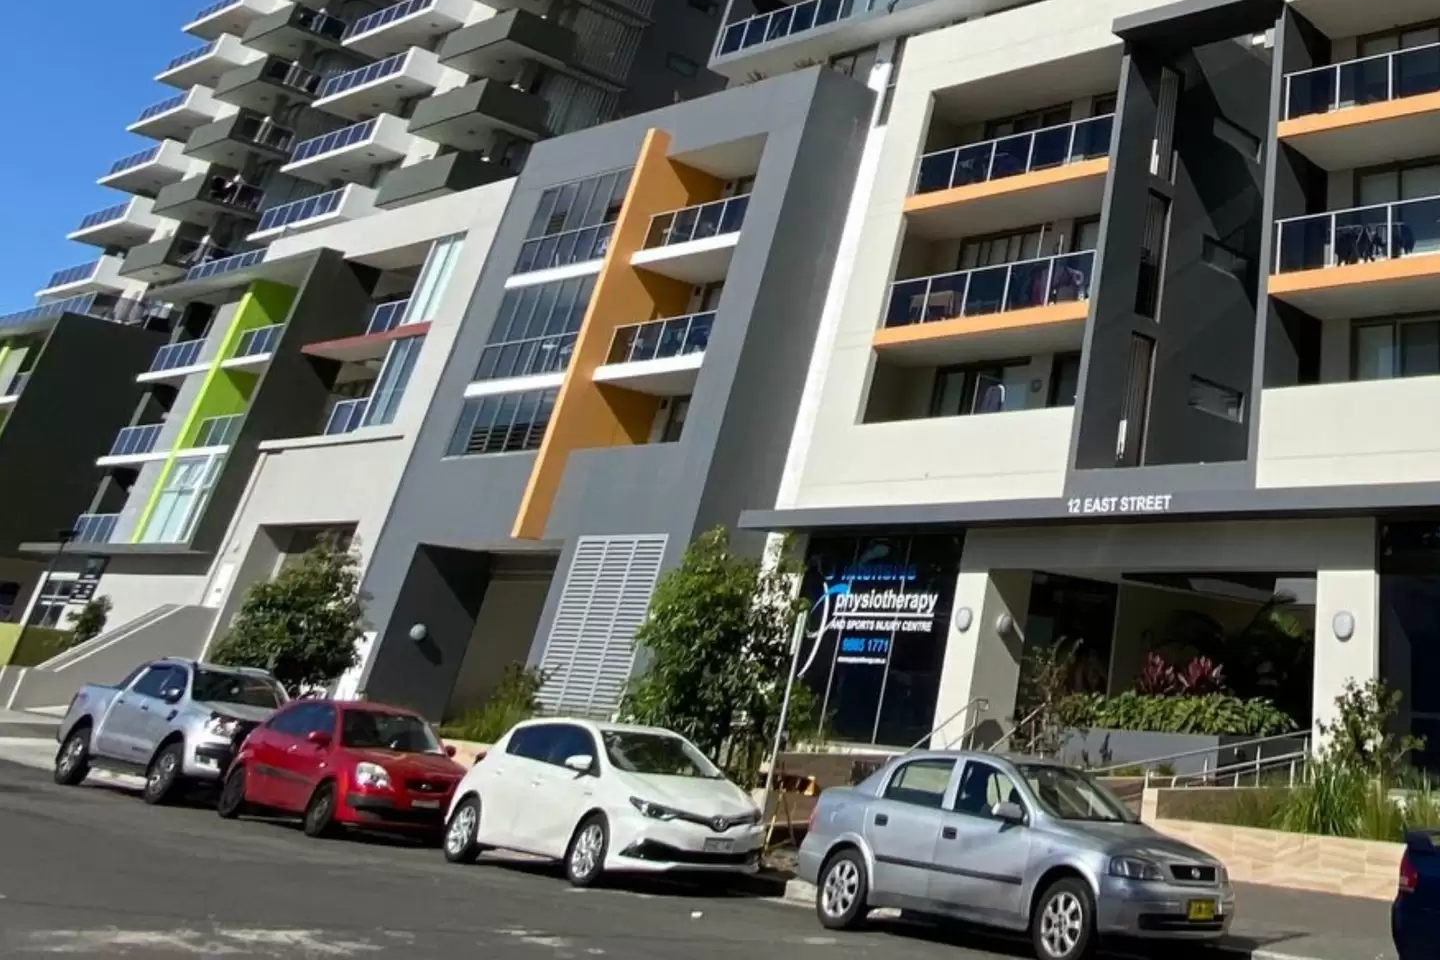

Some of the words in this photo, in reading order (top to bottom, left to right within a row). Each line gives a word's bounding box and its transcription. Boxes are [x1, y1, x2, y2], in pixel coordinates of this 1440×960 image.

[1067, 498, 1080, 513] 12
[1083, 496, 1118, 513] EAST
[1119, 494, 1172, 511] STREET
[834, 588, 939, 614] physiotherapy
[831, 619, 846, 630] AND
[846, 619, 875, 631] SPORTS
[875, 620, 901, 632] INJURY
[901, 621, 933, 632] CENTRE
[867, 639, 889, 653] 1771
